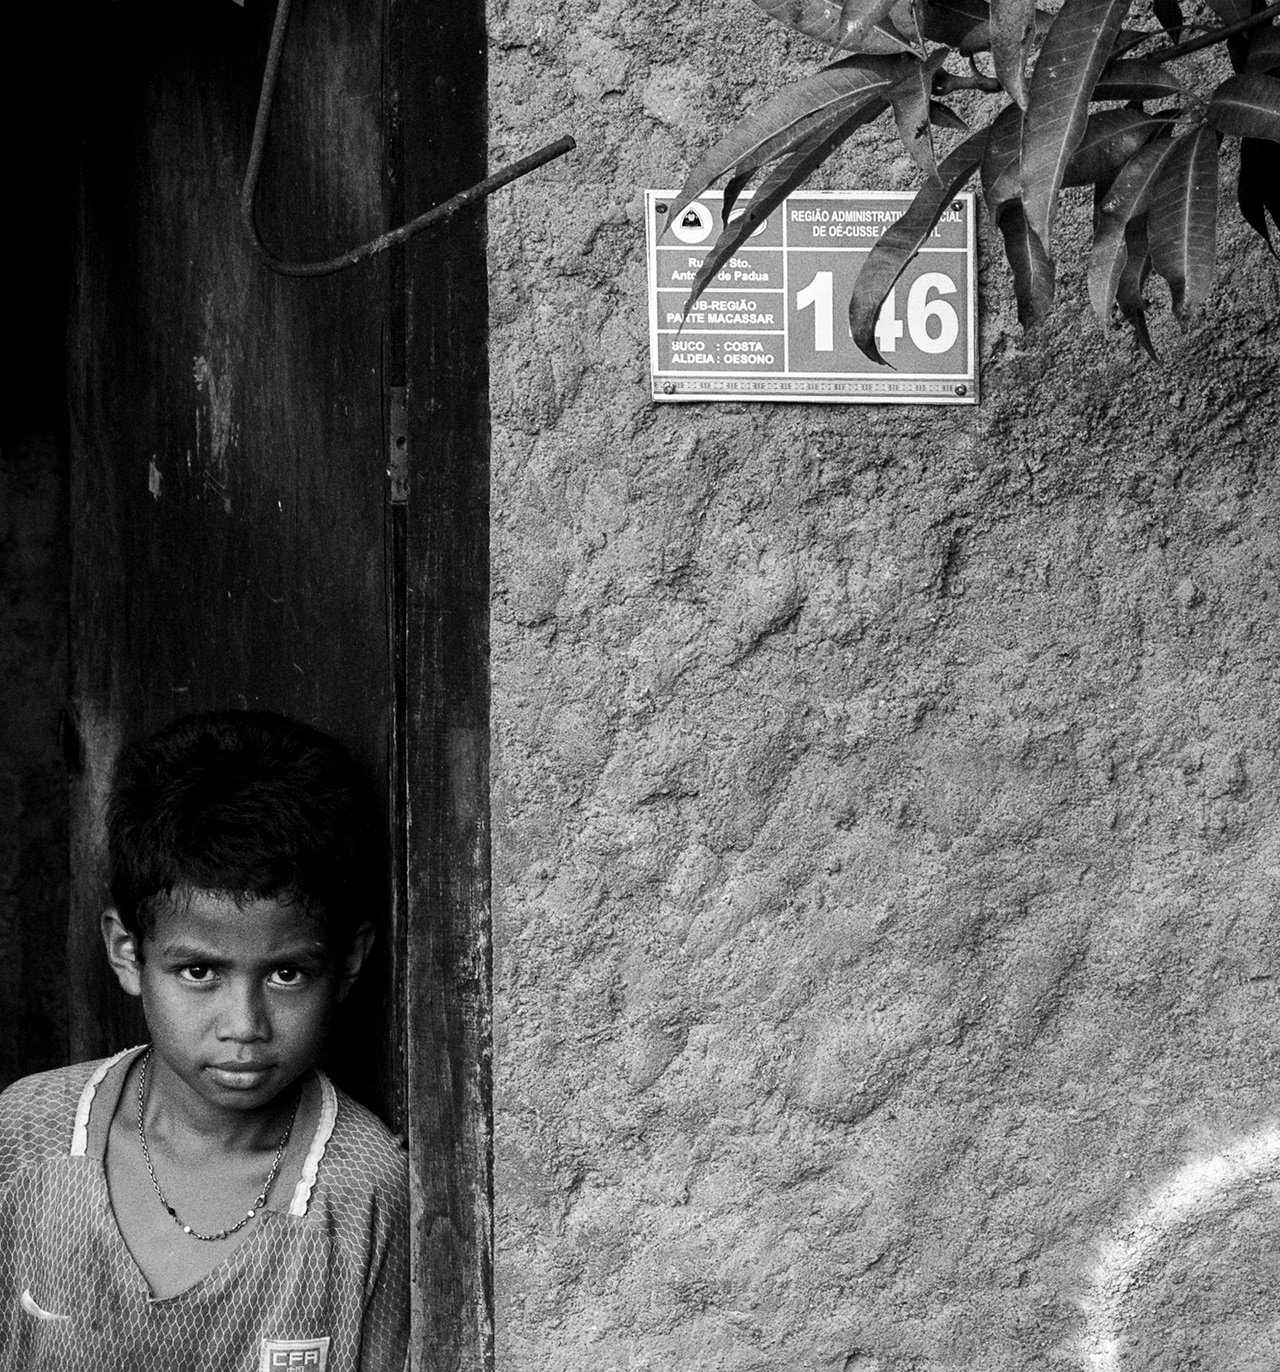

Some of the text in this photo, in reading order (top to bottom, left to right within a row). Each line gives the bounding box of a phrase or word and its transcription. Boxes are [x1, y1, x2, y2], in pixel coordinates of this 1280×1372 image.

[791, 208, 830, 222] REGIÃO
[831, 210, 906, 222] ADMINISTRATIV
[812, 225, 828, 237] DE
[829, 223, 880, 238] OÉ-CUSSE
[688, 258, 704, 268] Ru
[729, 258, 752, 268] Sto.
[717, 270, 732, 281] de
[734, 270, 769, 281] Padua
[684, 299, 757, 311] UB-REGIÃO
[707, 313, 775, 324] MACASSAR
[671, 341, 706, 351] SUCO
[723, 341, 764, 352] COSTA
[671, 353, 715, 364] ALDEIA
[723, 354, 775, 364] OESONO
[271, 1351, 318, 1367] CFA
